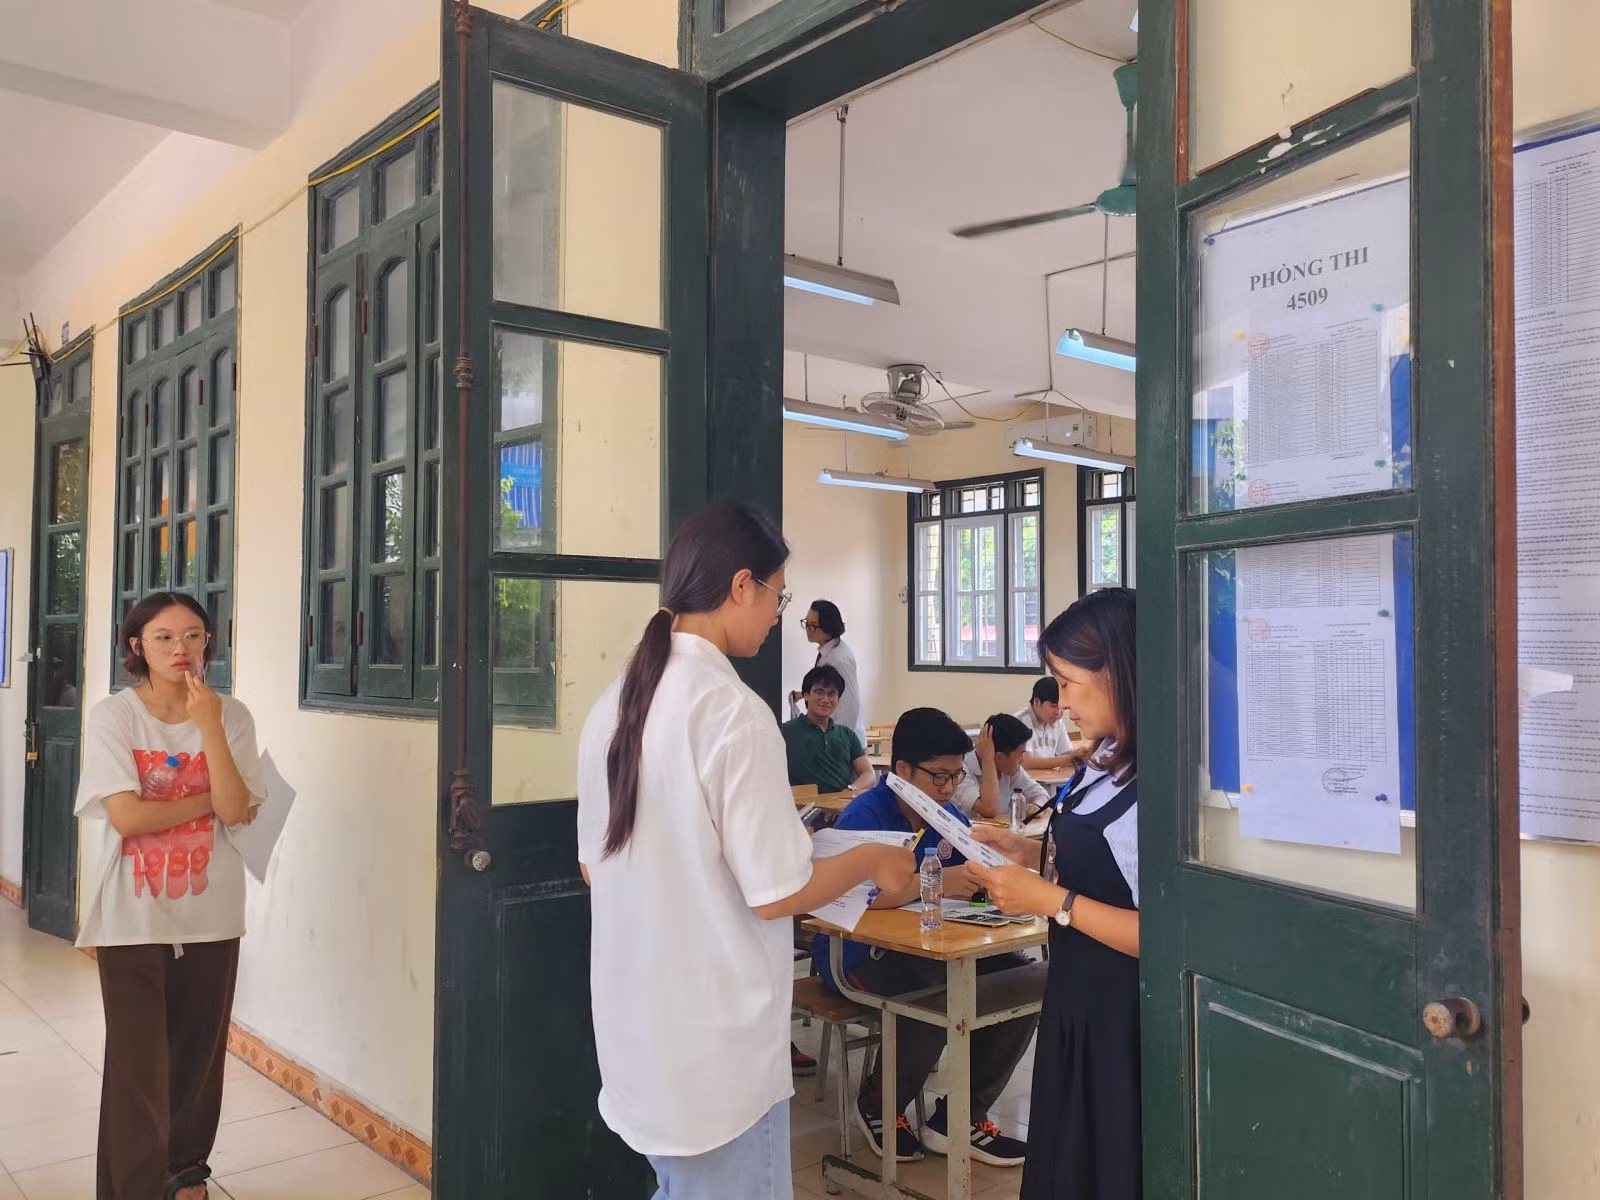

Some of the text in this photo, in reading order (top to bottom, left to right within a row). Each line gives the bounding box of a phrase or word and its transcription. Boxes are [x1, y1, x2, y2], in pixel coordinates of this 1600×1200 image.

[1249, 246, 1369, 291] PHÒNG THI
[1286, 287, 1329, 311] 4509
